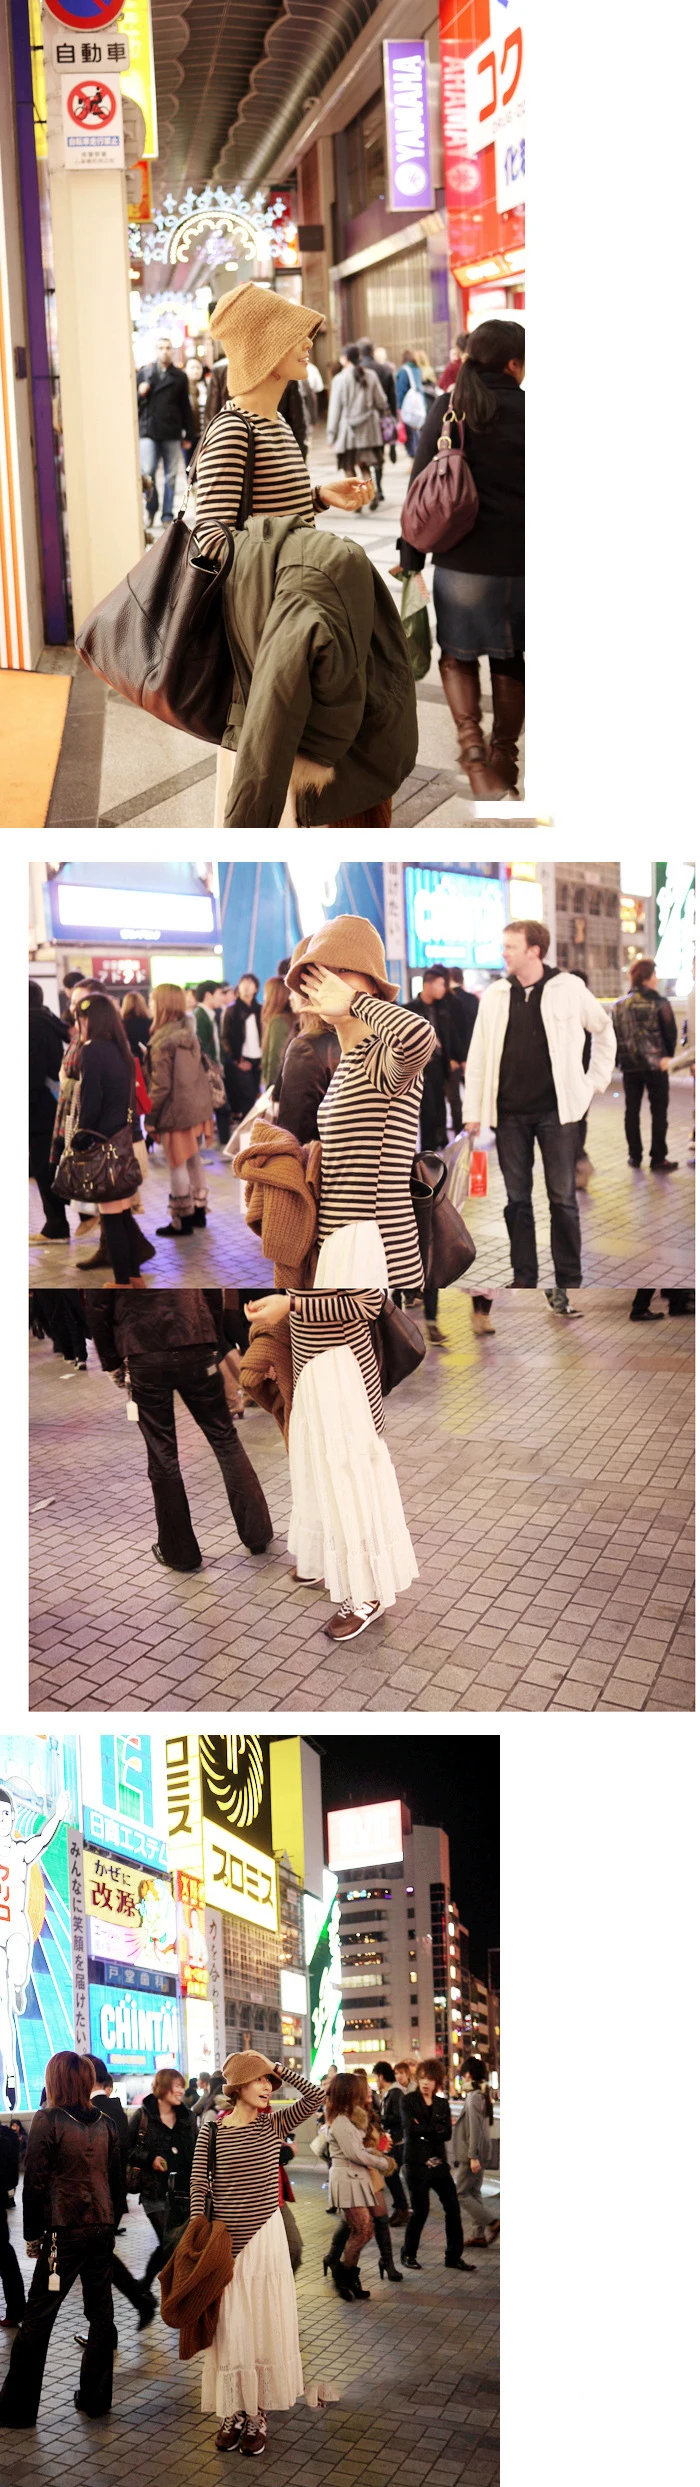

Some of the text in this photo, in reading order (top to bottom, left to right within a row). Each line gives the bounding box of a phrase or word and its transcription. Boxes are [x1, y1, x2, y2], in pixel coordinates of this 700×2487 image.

[56, 42, 126, 64] 自動車
[478, 26, 523, 123] コク
[392, 54, 425, 163] YAMAHA
[505, 138, 525, 186] 化
[166, 1735, 192, 1836] ロミス
[90, 1879, 136, 1917] 改源
[94, 1859, 131, 1887] かぜに
[212, 1843, 274, 1908] プロミス
[69, 1841, 88, 2054] みんなに笑顔を届けたい。
[101, 1994, 179, 2053] CHINTAI
